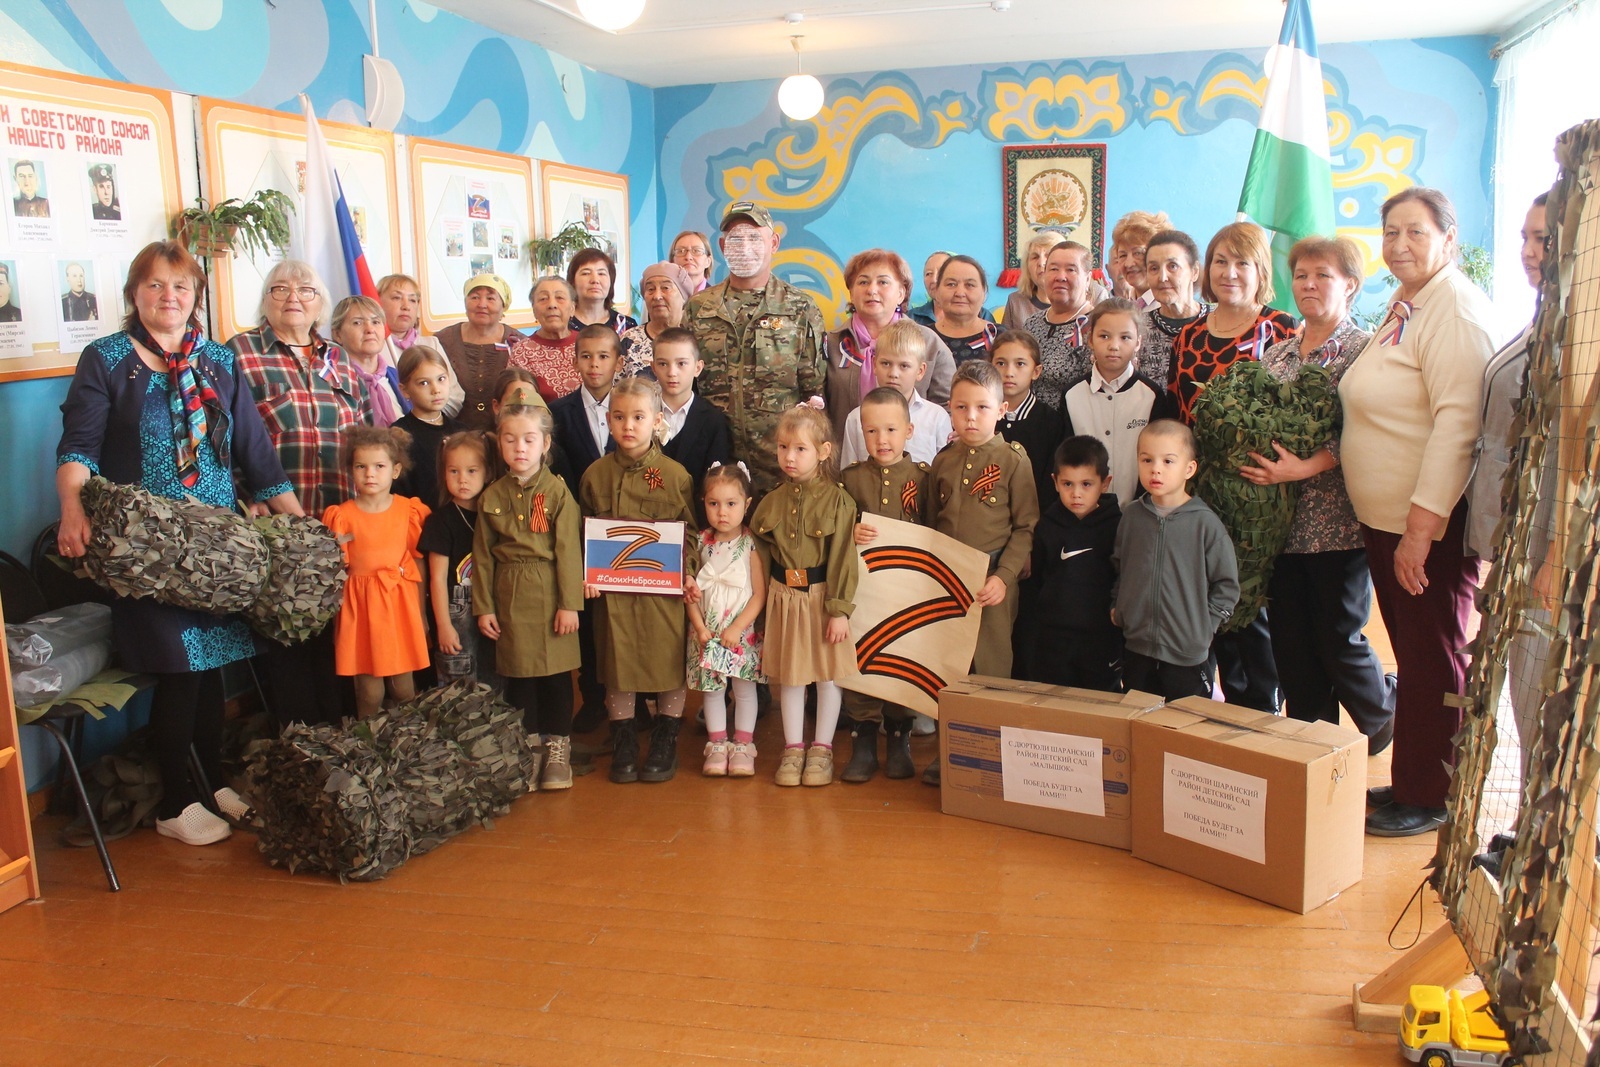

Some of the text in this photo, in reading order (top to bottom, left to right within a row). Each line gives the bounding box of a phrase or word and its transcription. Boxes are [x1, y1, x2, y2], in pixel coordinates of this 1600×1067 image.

[21, 107, 106, 136] СОВЕТСКОГО
[111, 119, 150, 141] СОЮЗА
[7, 126, 123, 156] НАШЕГО РАЙОНА
[606, 526, 665, 572] Z
[596, 574, 672, 587] #СвоихНеБросаем
[855, 545, 975, 704] Z
[1016, 750, 1088, 767] РАЙОН ДЕТСКИЙ САД
[1050, 746, 1096, 758] ШАРАНСКИЙ
[1029, 761, 1075, 772] «МАЛЫШОК»
[1023, 778, 1083, 794] ПОБЕДА БУДЕТ ЗА
[1178, 779, 1251, 808] РАЙОН ДЕТСКИЙ САД
[1213, 780, 1259, 799] ШАРАНСКИЙ
[1191, 794, 1237, 811] «МАЛЫШОК»
[1183, 811, 1244, 836] ПОБЕДА БУДЕТ ЗА
